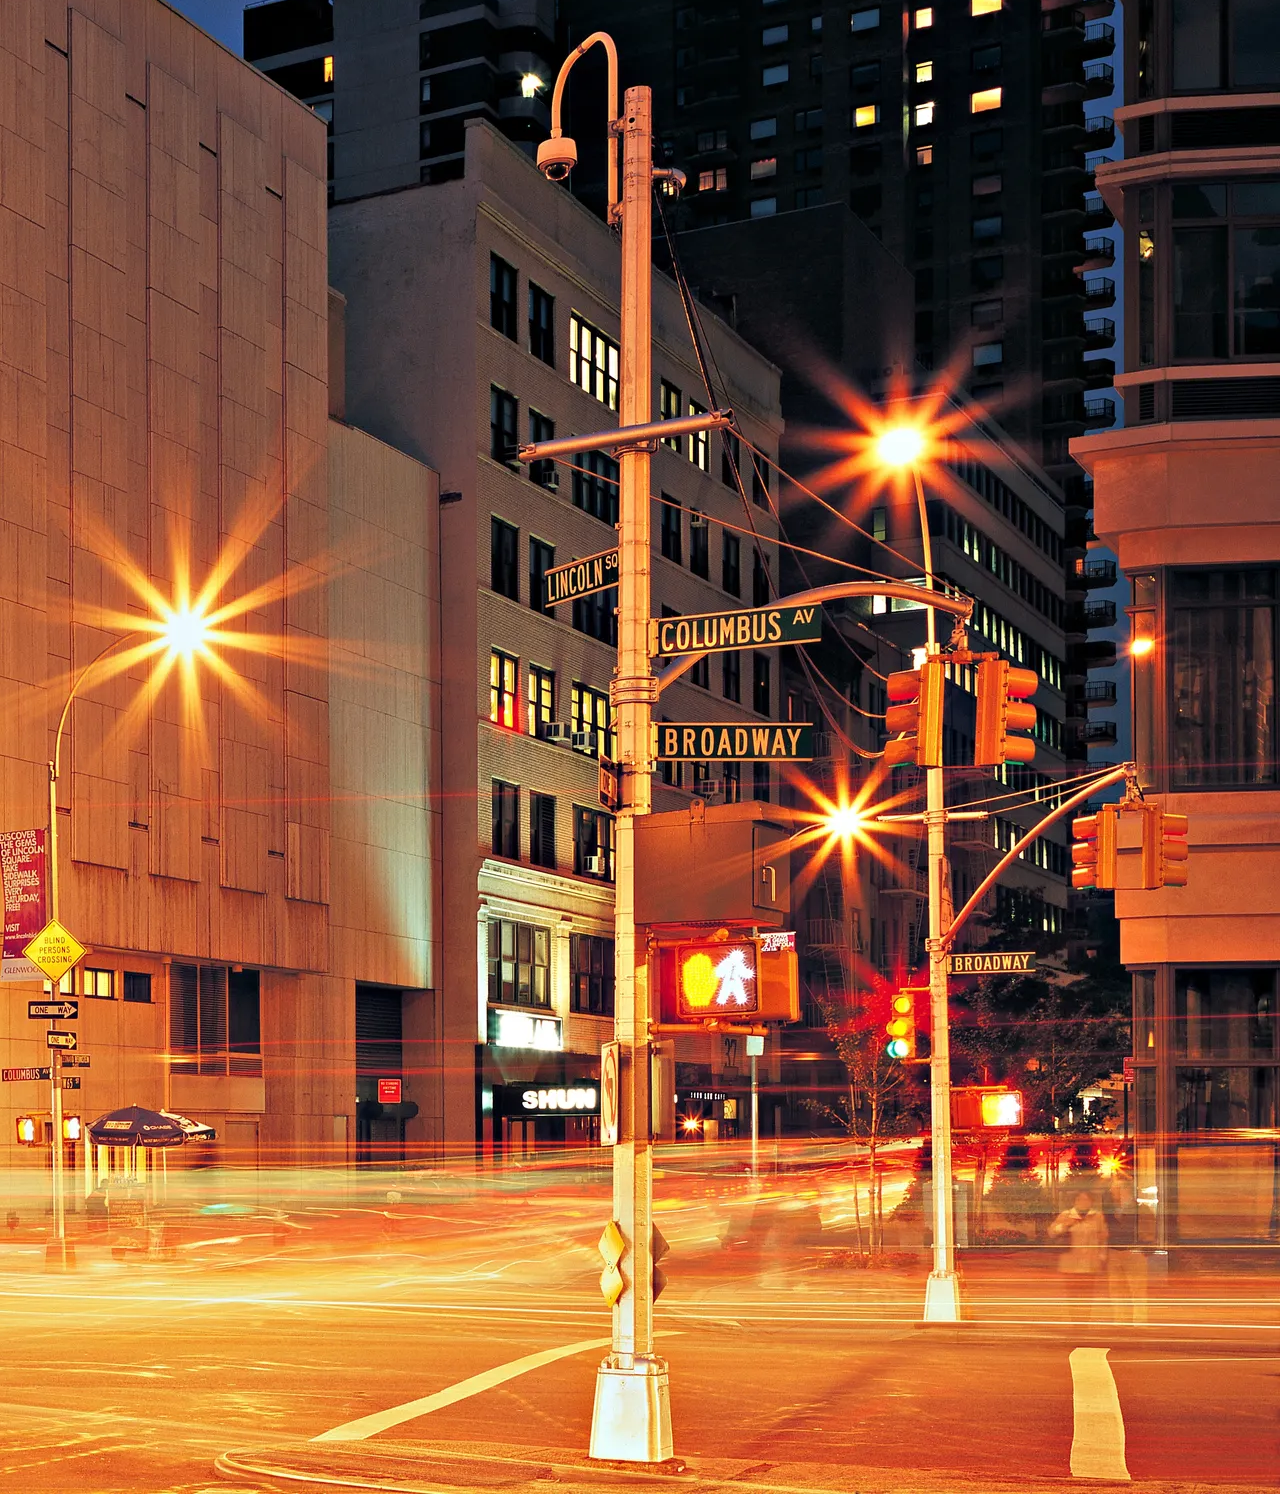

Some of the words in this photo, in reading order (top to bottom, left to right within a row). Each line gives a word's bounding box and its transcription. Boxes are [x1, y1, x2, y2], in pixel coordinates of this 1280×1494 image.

[548, 564, 603, 602] LINCOLN
[605, 553, 618, 570] SQ
[661, 611, 782, 652] COLUMBUS
[793, 608, 815, 624] AV
[665, 728, 802, 756] BROADWAY
[0, 830, 36, 842] DISCOVER
[0, 841, 14, 850] THE
[15, 838, 37, 848] GEMS
[1, 849, 11, 857] OF
[12, 845, 44, 856] LINCOLN
[2, 855, 32, 865] SQUARE.
[3, 864, 18, 873] TAKE
[4, 870, 37, 881] SIDEWALK
[4, 878, 40, 889] SURPRISES
[5, 887, 23, 897] EVERY
[5, 894, 40, 905] SATURDAY,
[5, 923, 20, 932] VISIT
[44, 936, 66, 944] BLIND
[39, 946, 71, 954] PERSONS
[37, 955, 73, 964] CROSSING
[955, 955, 1029, 971] BROADWAY
[4, 966, 42, 974] GLENWOO
[34, 1006, 48, 1014] ONE
[57, 1006, 72, 1014] WAY
[3, 1068, 40, 1081] COLUMBUS
[522, 1089, 596, 1110] SHUN
